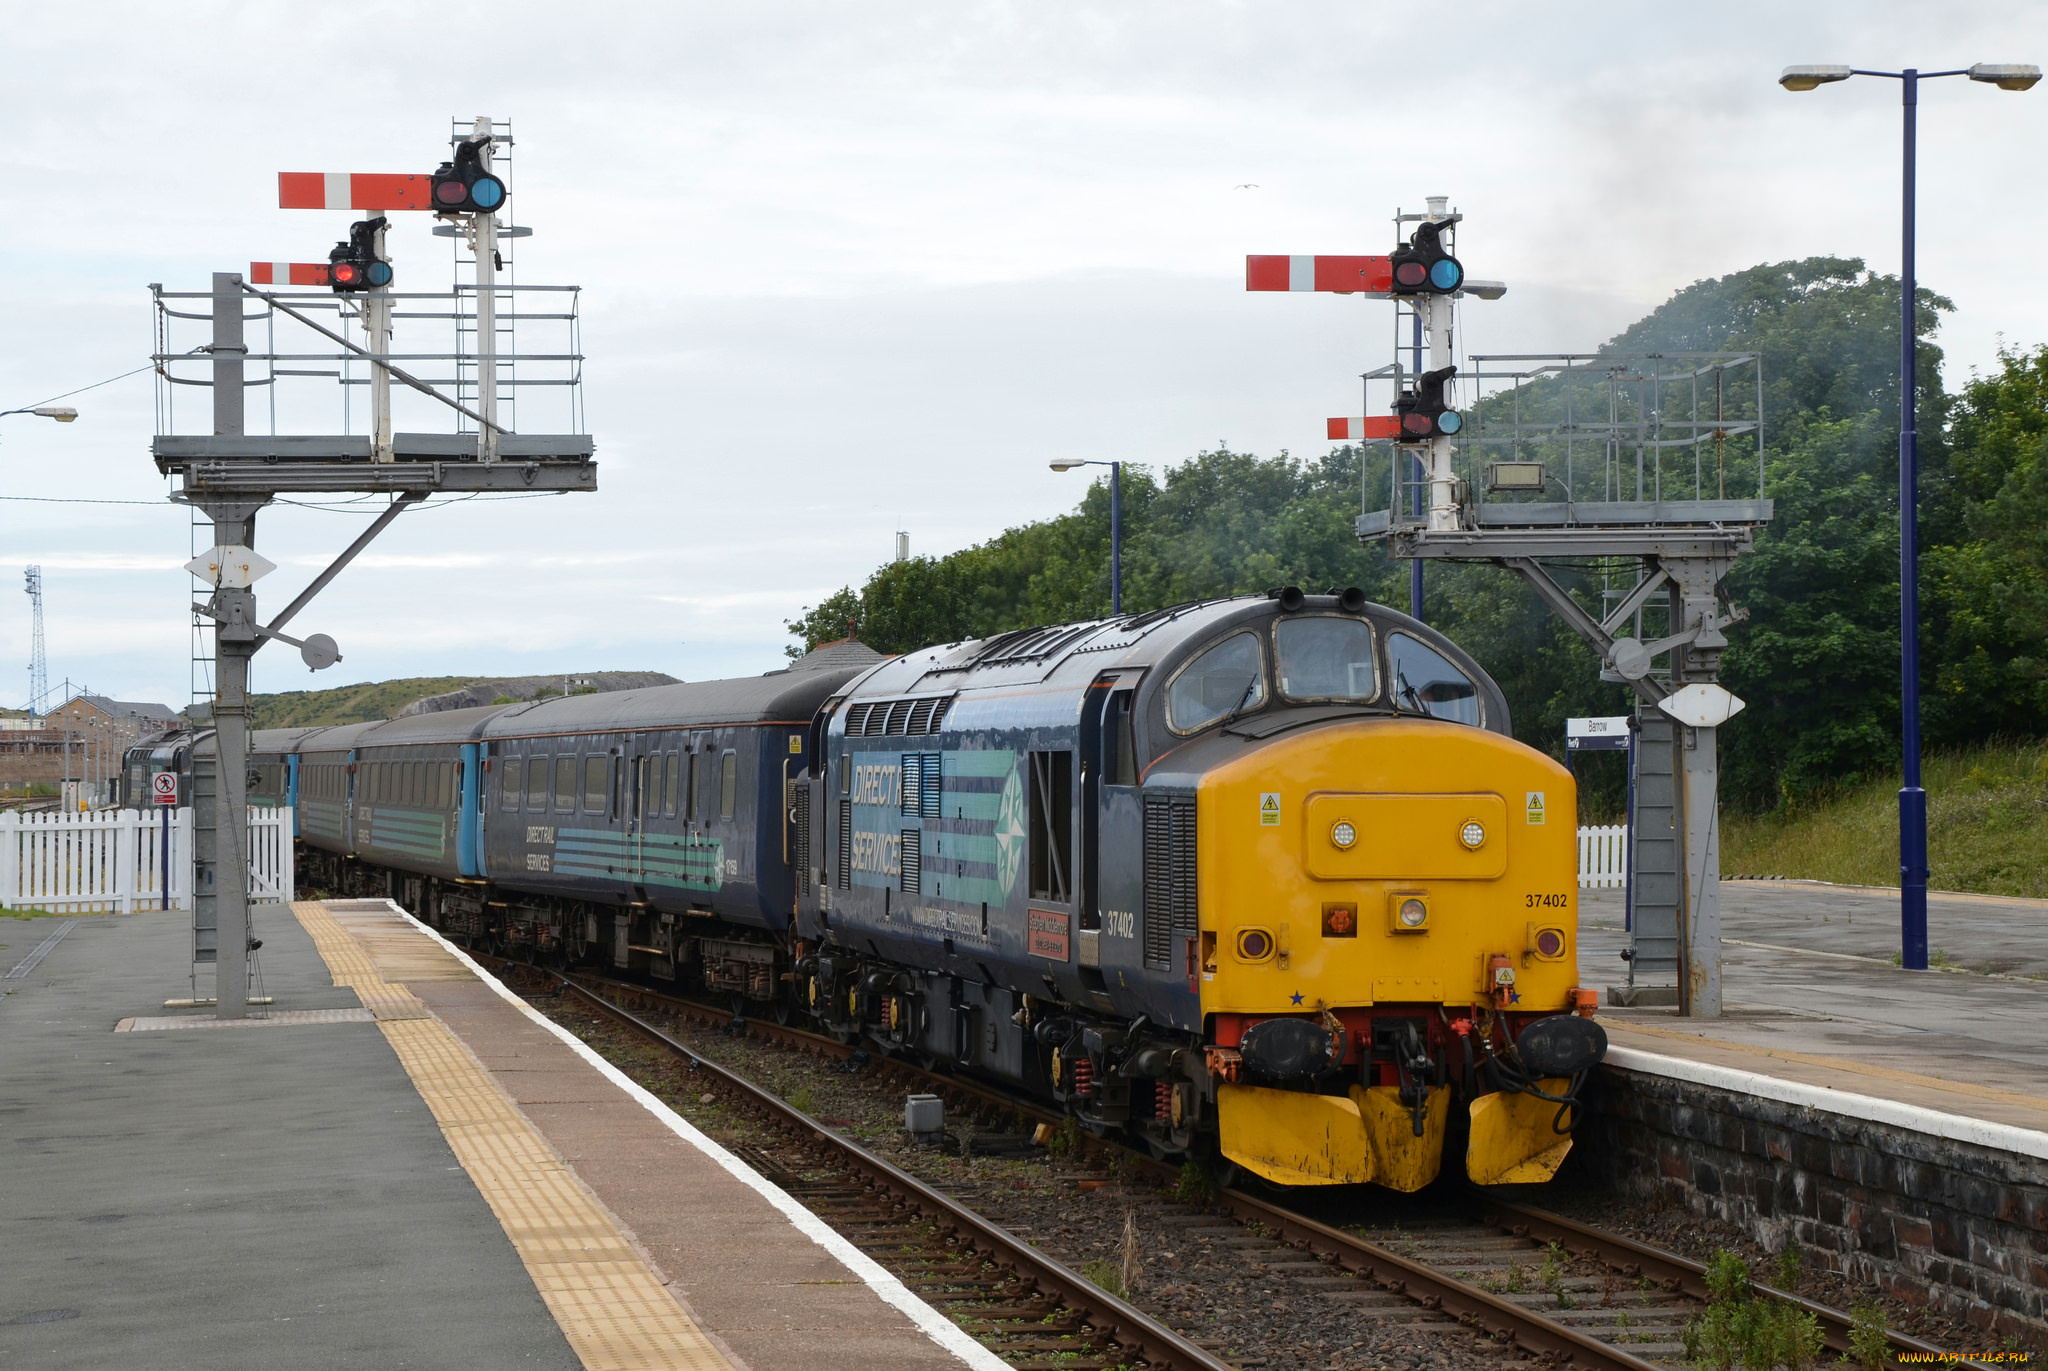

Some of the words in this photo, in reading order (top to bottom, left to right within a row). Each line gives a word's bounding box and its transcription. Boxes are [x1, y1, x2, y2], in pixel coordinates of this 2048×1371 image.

[1588, 720, 1607, 732] Barrow
[853, 765, 896, 806] DIRECT
[526, 854, 550, 872] SERVICES
[1525, 894, 1567, 908] 37402
[1107, 910, 1134, 939] 37402
